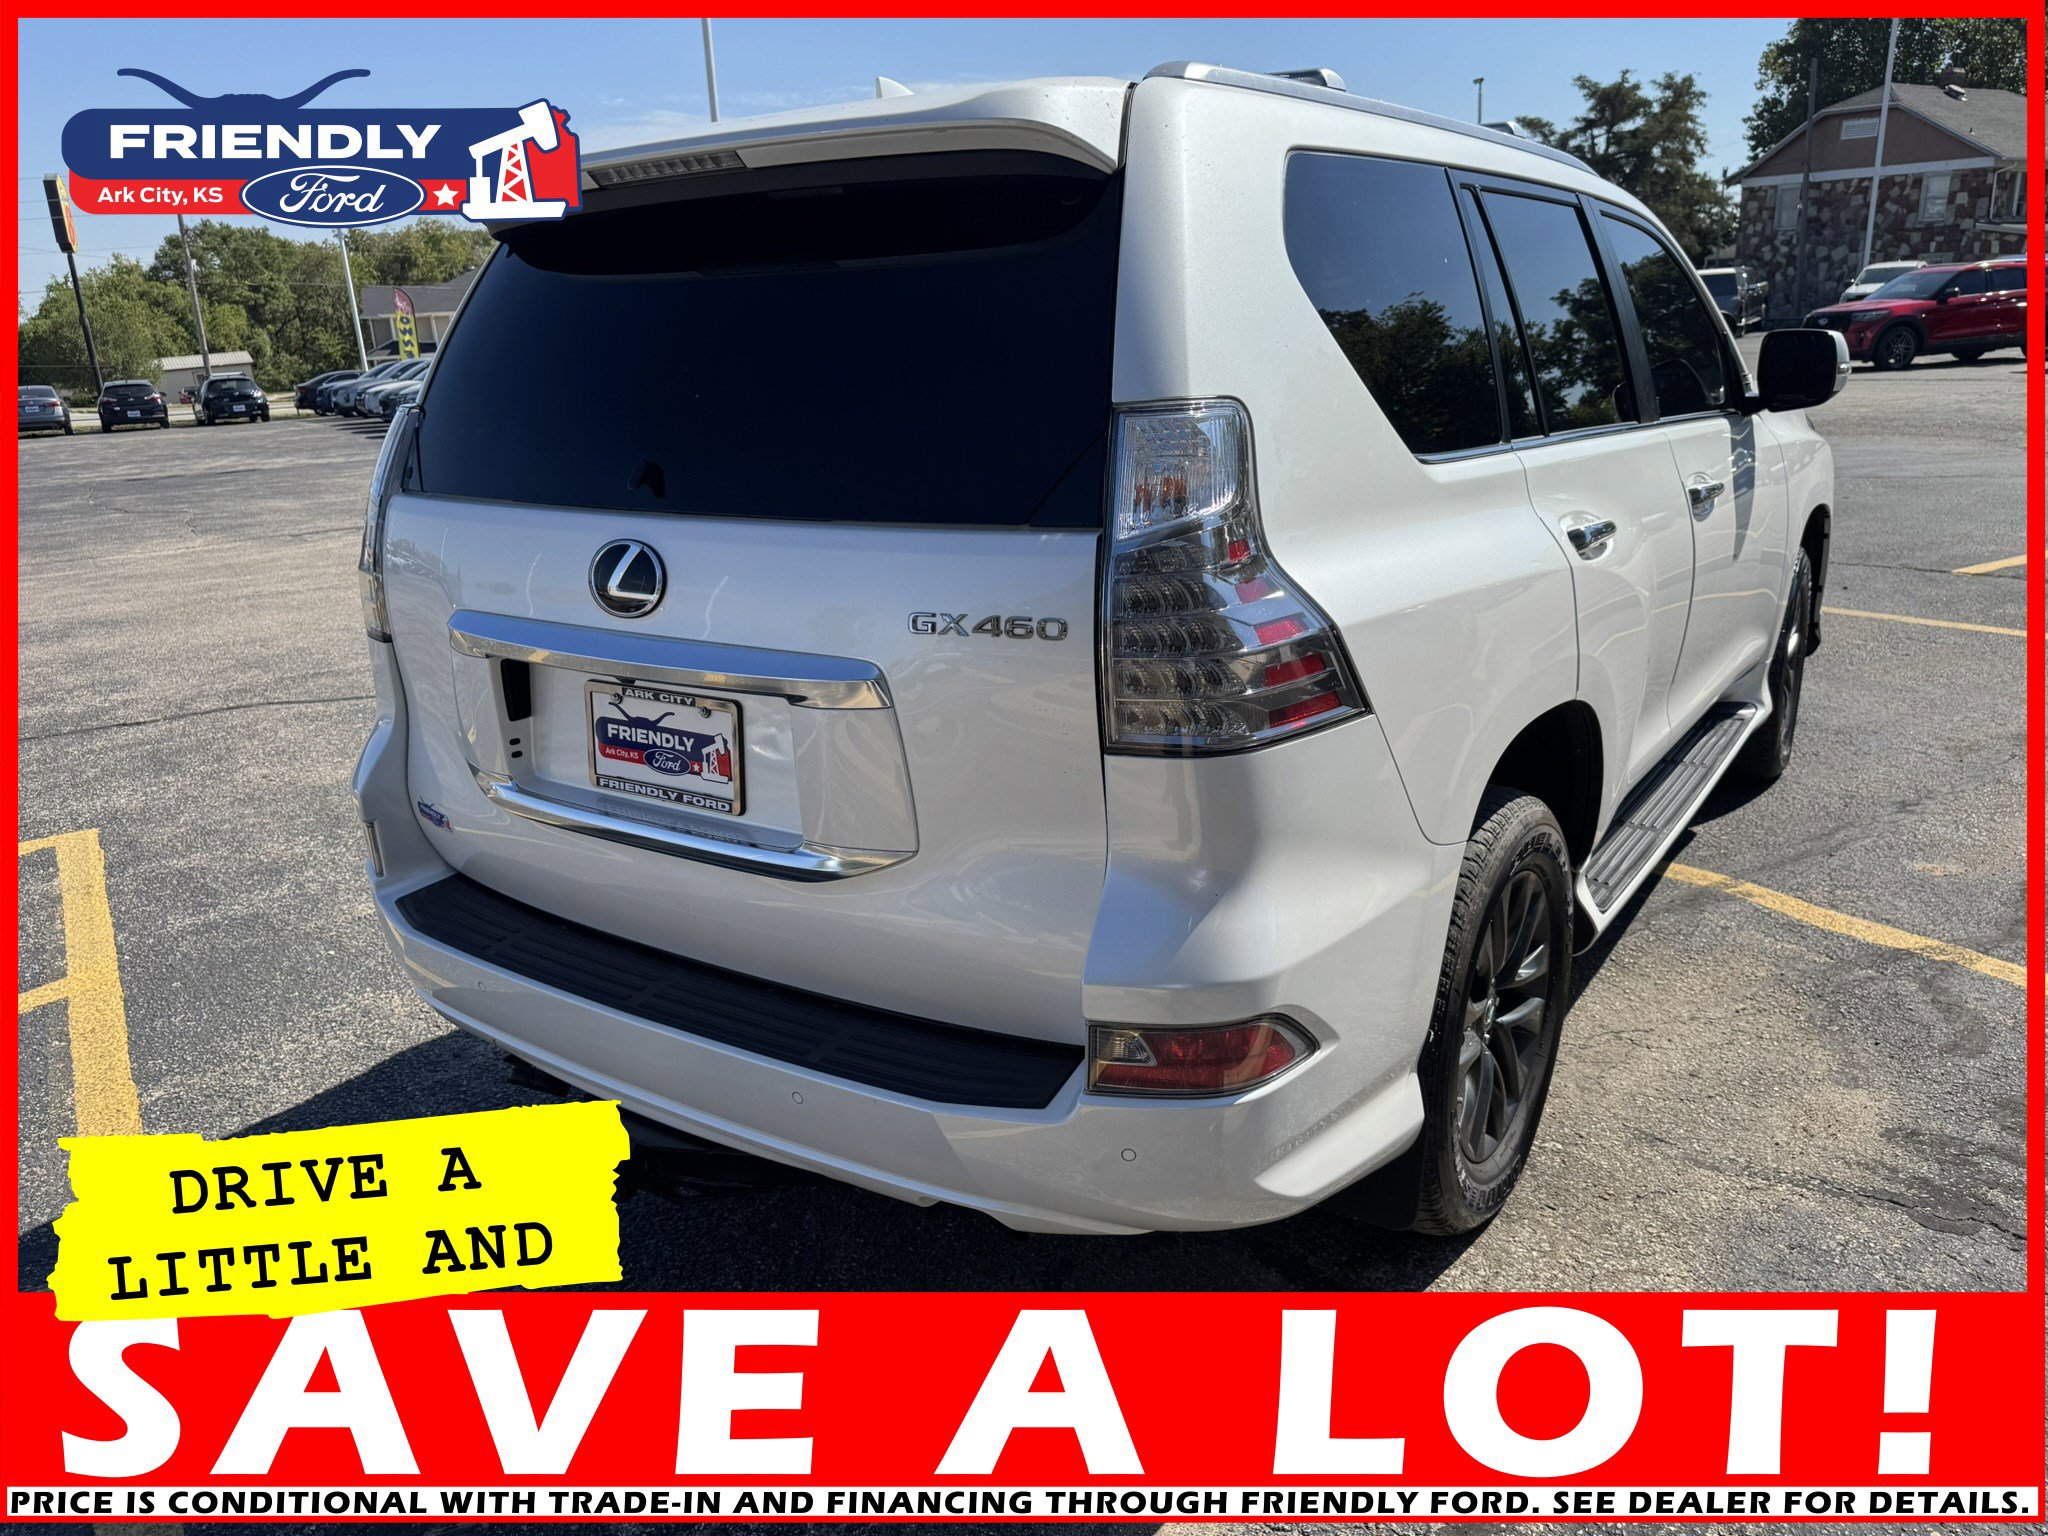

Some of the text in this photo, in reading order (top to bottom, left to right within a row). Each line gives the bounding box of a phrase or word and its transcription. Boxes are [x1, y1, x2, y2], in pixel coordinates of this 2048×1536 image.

[625, 688, 694, 706] ARK CITY
[607, 723, 694, 753] FRIENDLY
[652, 751, 682, 772] Ford
[600, 779, 731, 812] FRIENDLY FORD
